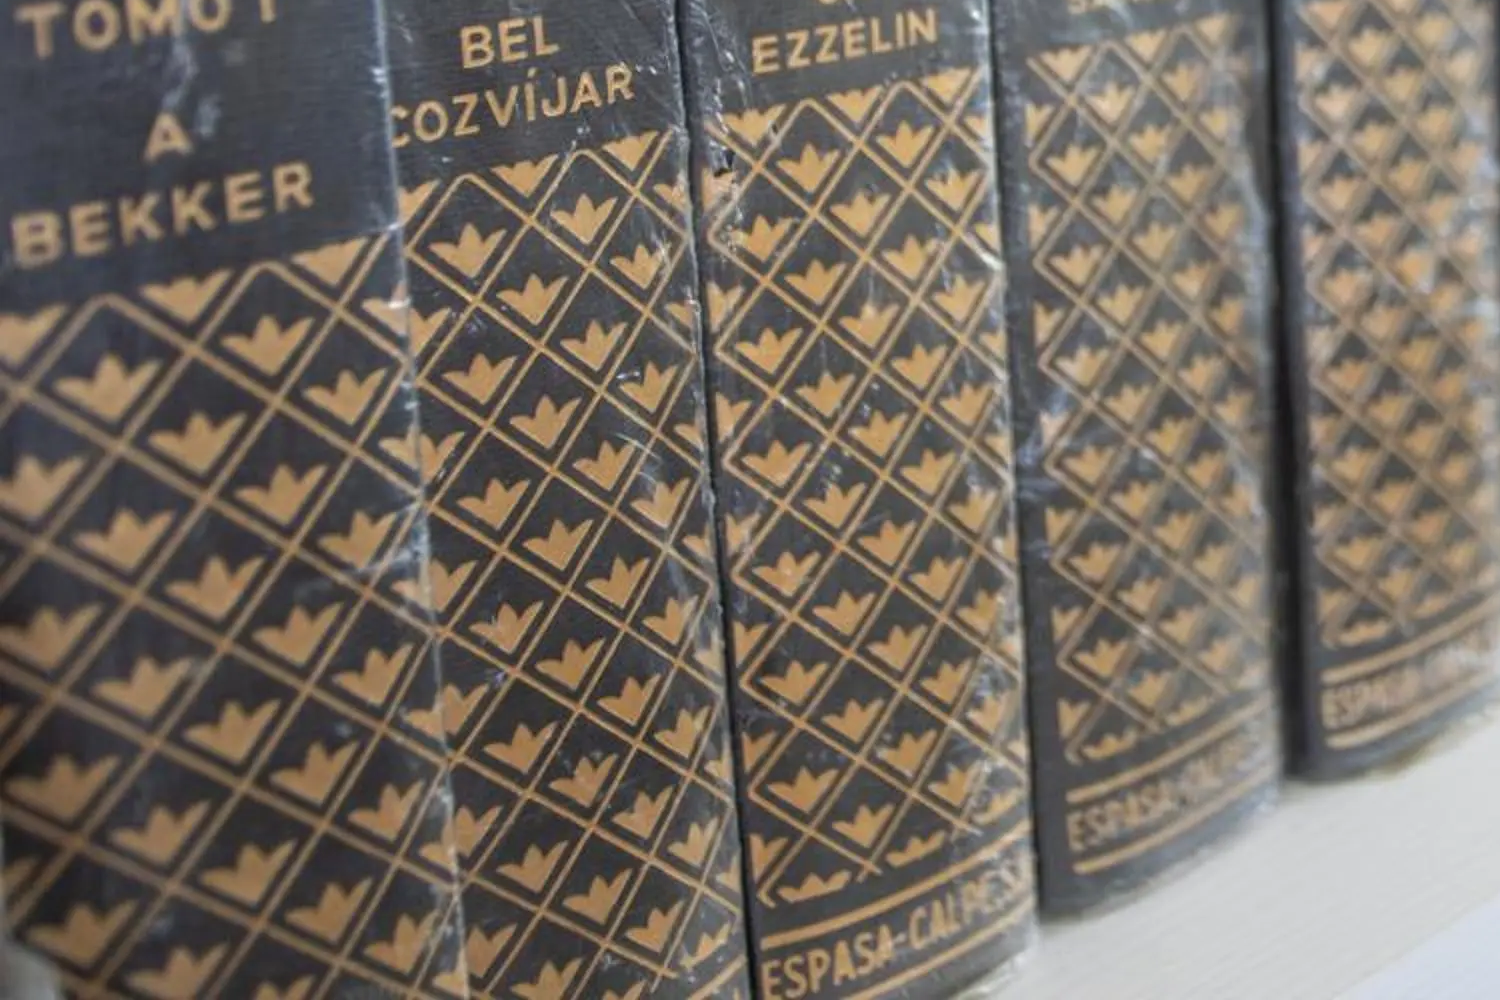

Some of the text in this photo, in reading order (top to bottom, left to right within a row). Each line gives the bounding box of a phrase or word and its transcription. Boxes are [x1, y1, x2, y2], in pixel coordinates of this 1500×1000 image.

[460, 15, 560, 69] BEL
[752, 8, 938, 76] EZZELIN
[144, 112, 193, 161] A
[11, 161, 314, 269] BEKKER
